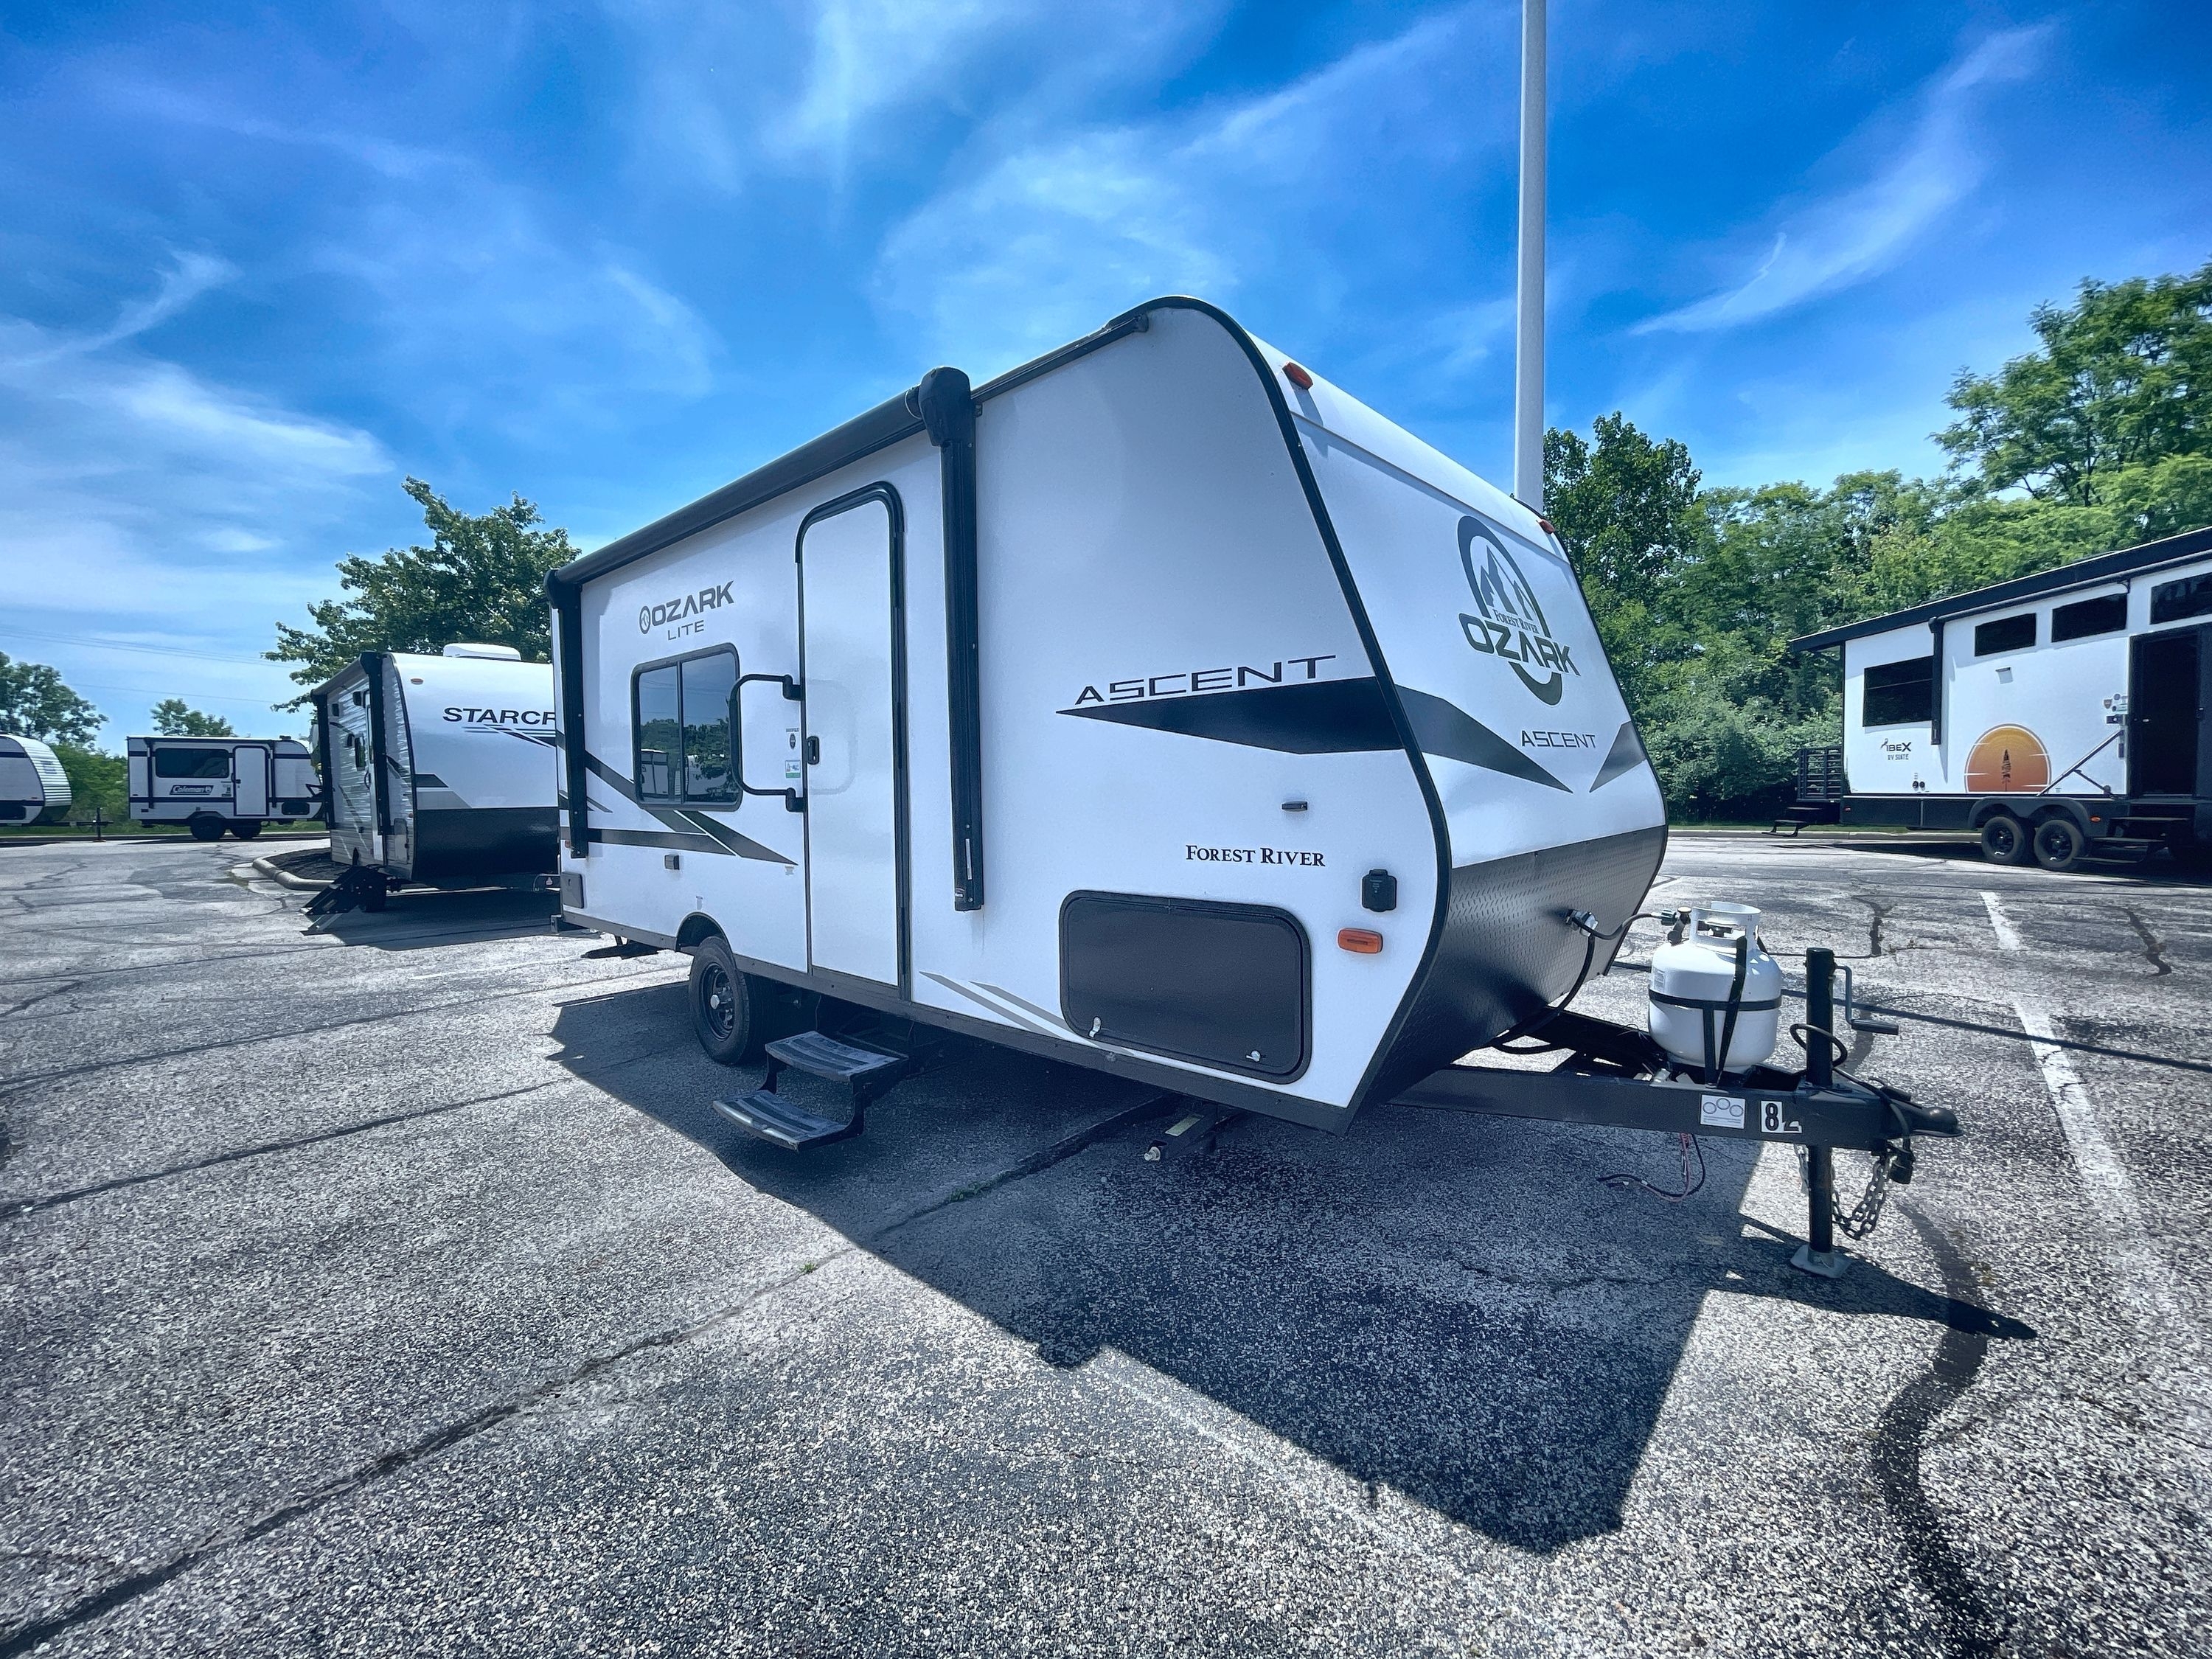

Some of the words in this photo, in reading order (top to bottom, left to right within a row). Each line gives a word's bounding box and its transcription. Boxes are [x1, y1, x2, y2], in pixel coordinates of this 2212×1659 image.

[652, 580, 734, 627] OZARK
[667, 620, 704, 641] LITE
[1492, 609, 1519, 627] FOREST
[1517, 618, 1540, 634] RIVER
[1458, 613, 1581, 676] OZARK
[1074, 655, 1336, 705] ASCENT
[1521, 730, 1596, 748] ASCENT
[1186, 844, 1256, 863] FOREST
[1259, 847, 1326, 867] RIVER
